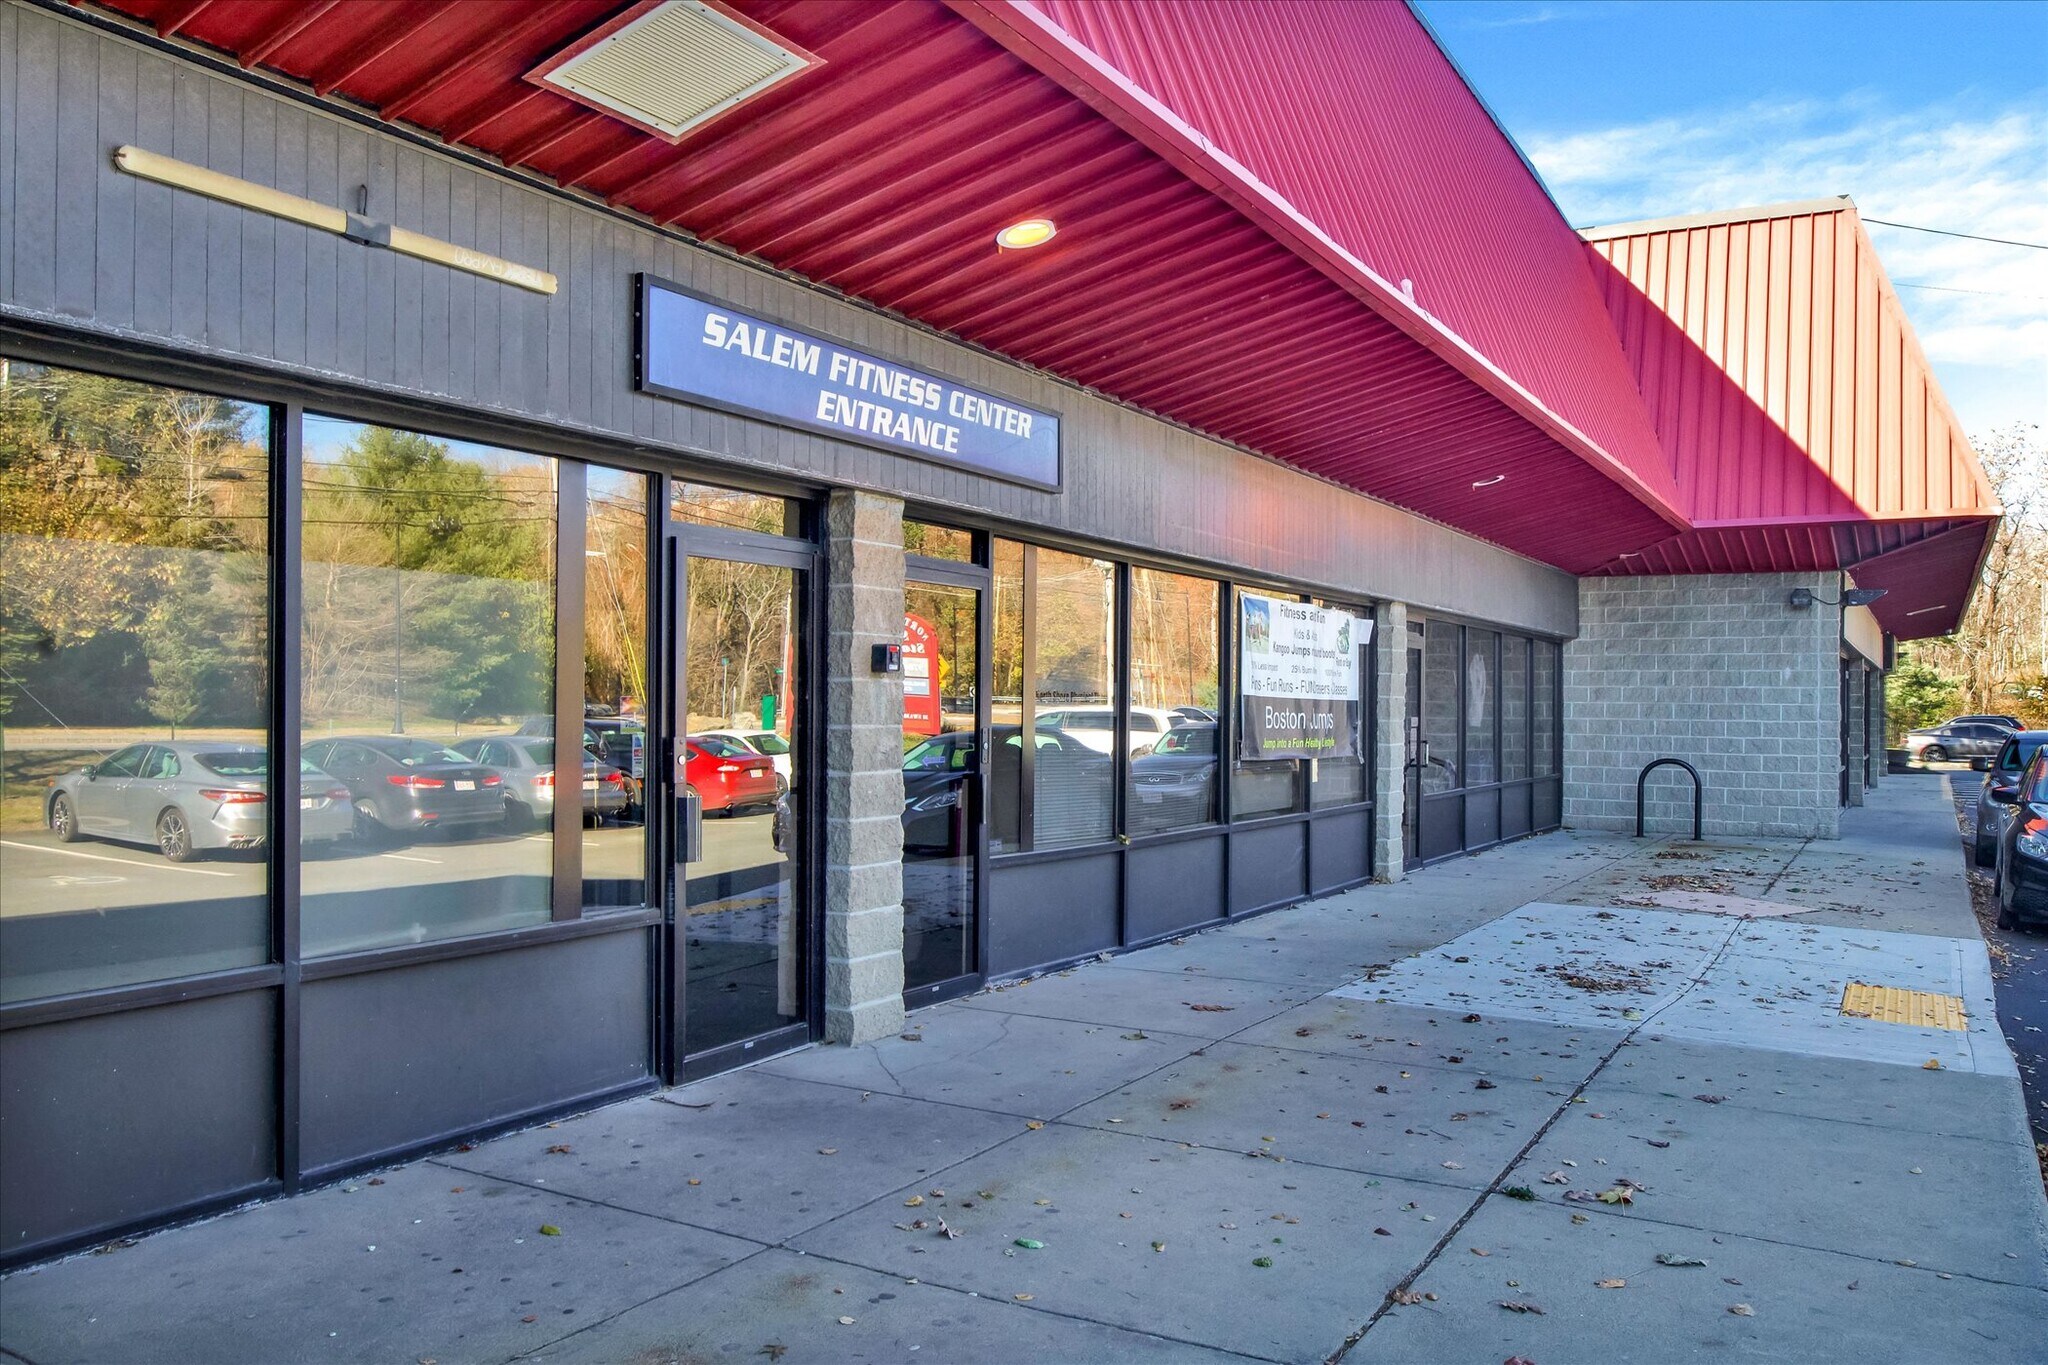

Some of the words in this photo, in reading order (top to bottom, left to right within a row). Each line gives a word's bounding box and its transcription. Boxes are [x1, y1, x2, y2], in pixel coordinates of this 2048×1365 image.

[702, 313, 820, 376] SALEM
[829, 352, 941, 411] FITNESS
[949, 390, 1032, 439] CENTER
[816, 391, 960, 454] ENTRANCE
[1280, 604, 1307, 620] Fitness
[1273, 642, 1290, 657] Kangoo
[1291, 644, 1311, 658] Jumps
[1267, 677, 1277, 691] Fun
[1279, 679, 1294, 693] Runs
[1265, 706, 1306, 729] Boston
[1310, 708, 1334, 734] Jumps
[1263, 737, 1277, 750] Jump
[1277, 738, 1287, 748] into
[1292, 737, 1304, 748] Fun
